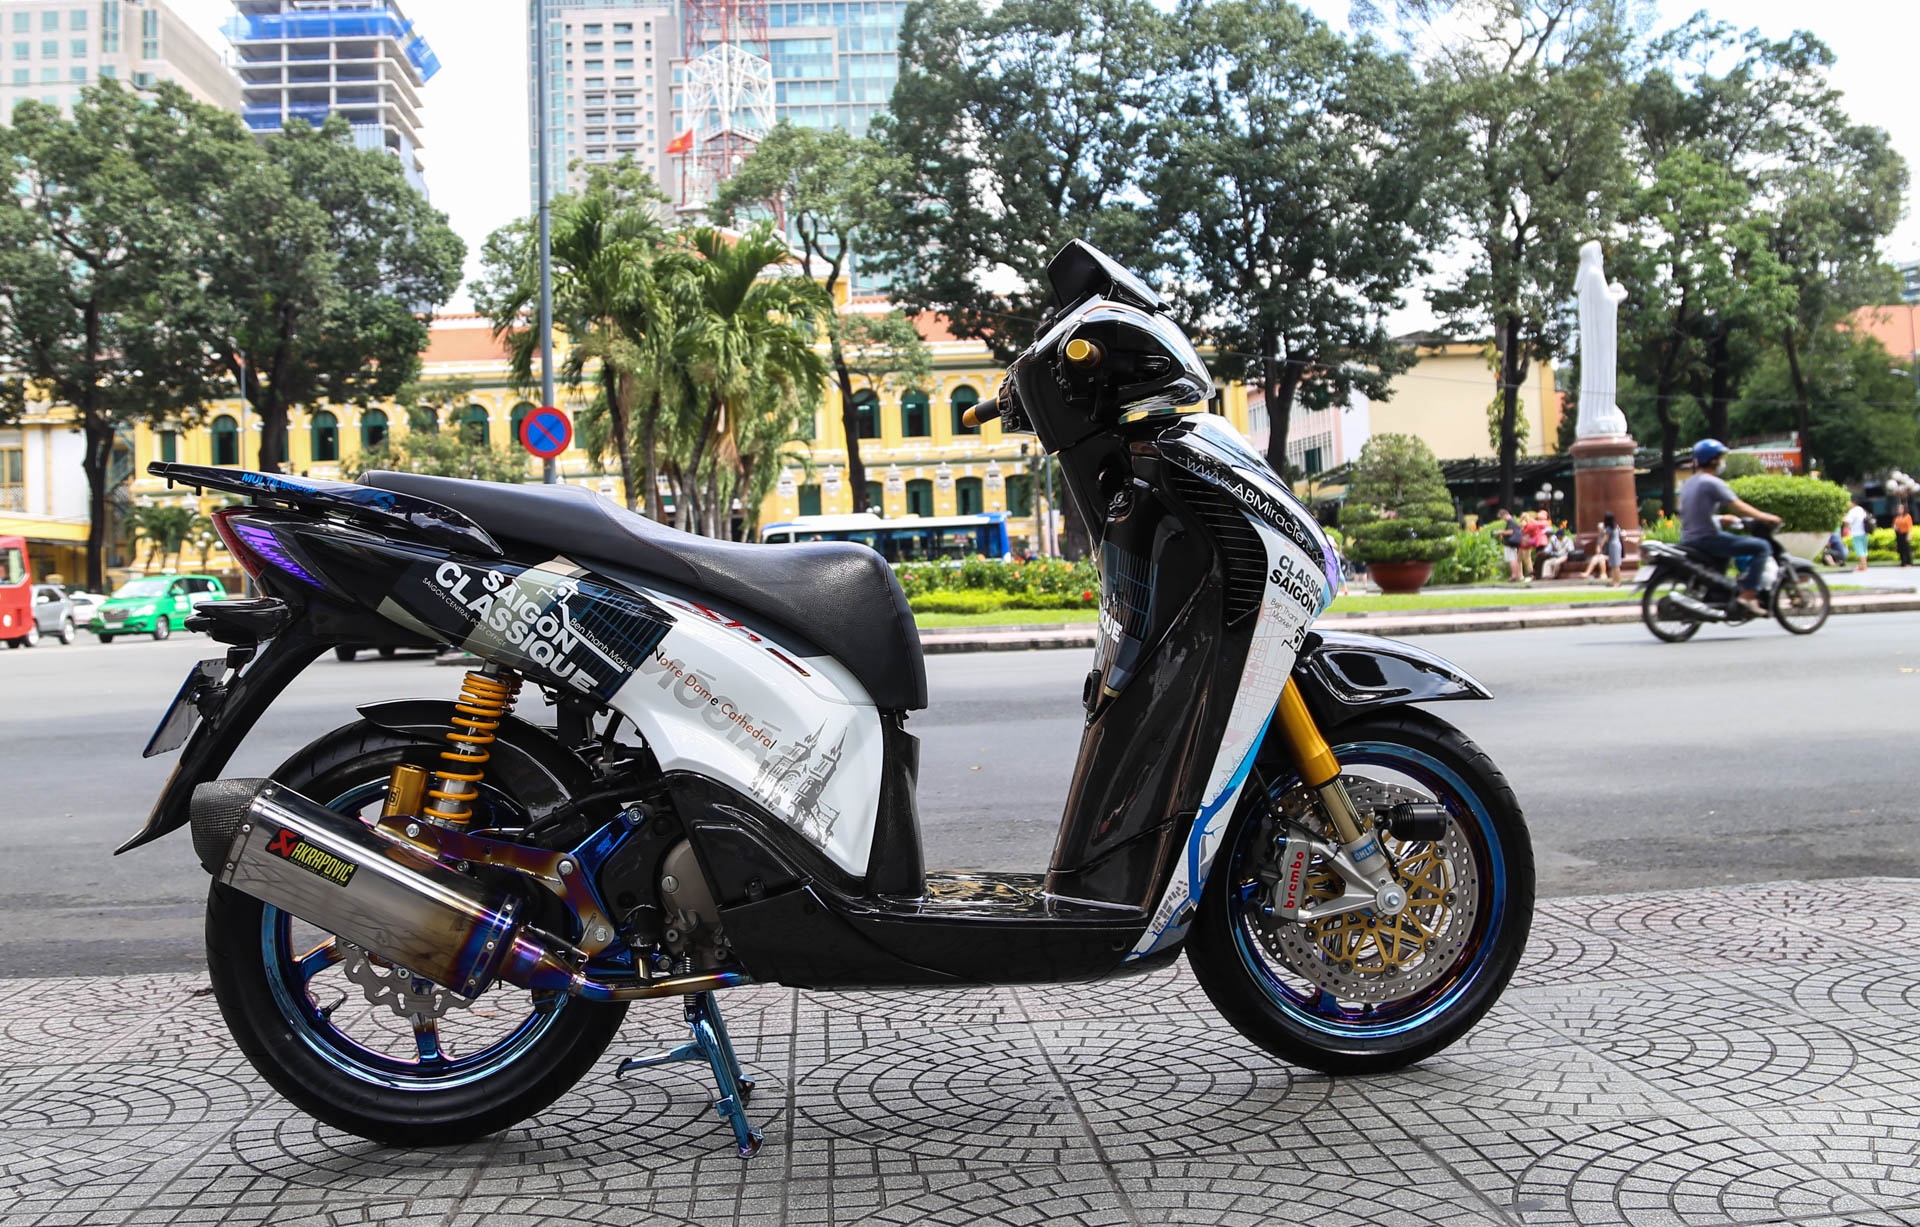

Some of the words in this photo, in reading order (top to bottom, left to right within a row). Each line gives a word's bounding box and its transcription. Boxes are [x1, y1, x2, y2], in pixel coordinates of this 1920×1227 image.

[422, 577, 446, 601] SAIGON
[445, 597, 471, 621] CENTRAL
[469, 617, 486, 632] POST
[435, 561, 599, 694] CLASSIQUE
[569, 617, 586, 635] Ben
[586, 628, 609, 654] Thanh
[655, 643, 683, 678] Notre
[684, 674, 719, 706] Dame
[721, 703, 778, 750] Cathedral
[1283, 851, 1305, 909] brembo
